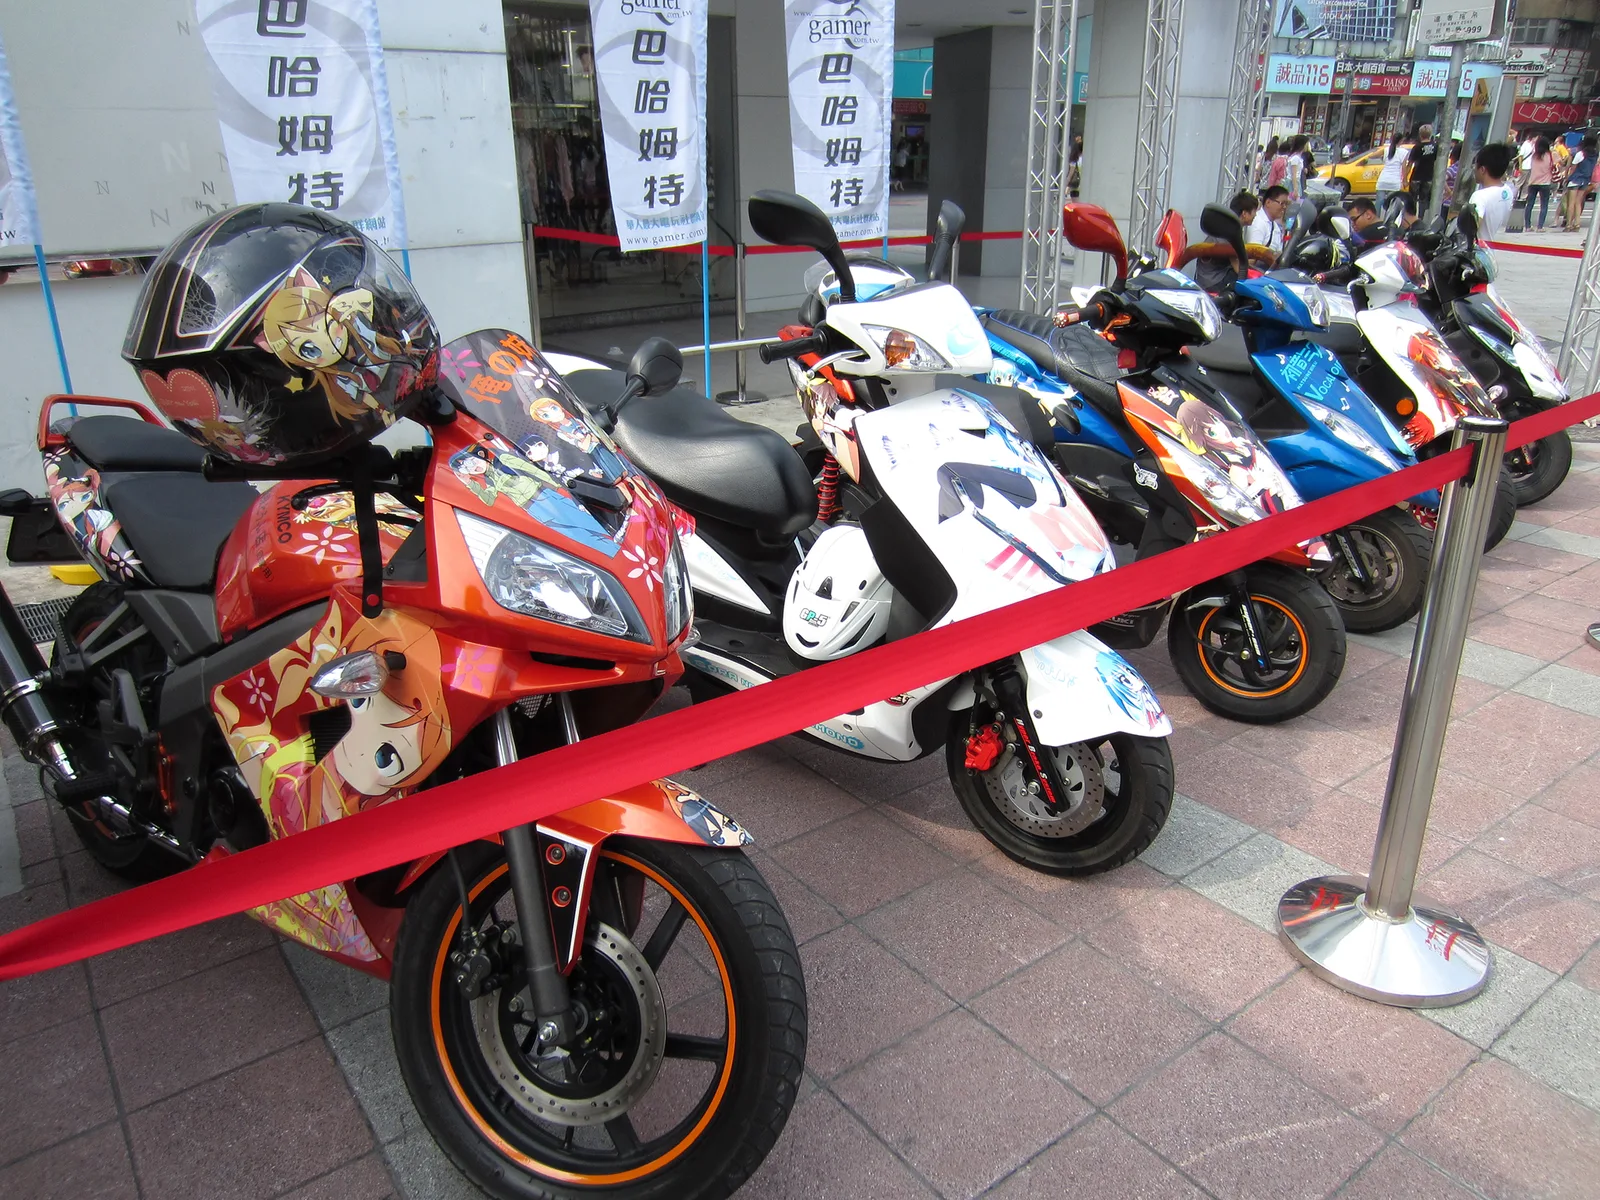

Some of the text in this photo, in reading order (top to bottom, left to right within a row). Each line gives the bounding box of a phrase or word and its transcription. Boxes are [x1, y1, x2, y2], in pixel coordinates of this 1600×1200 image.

[808, 18, 871, 44] gamer
[256, 0, 344, 211] 巴哈姆特
[1382, 77, 1409, 88] DAISO
[632, 29, 684, 209] 巴哈姆特
[818, 53, 864, 208] 巴哈姆特
[277, 494, 292, 544] KYMCO
[799, 607, 829, 627] GP-5
